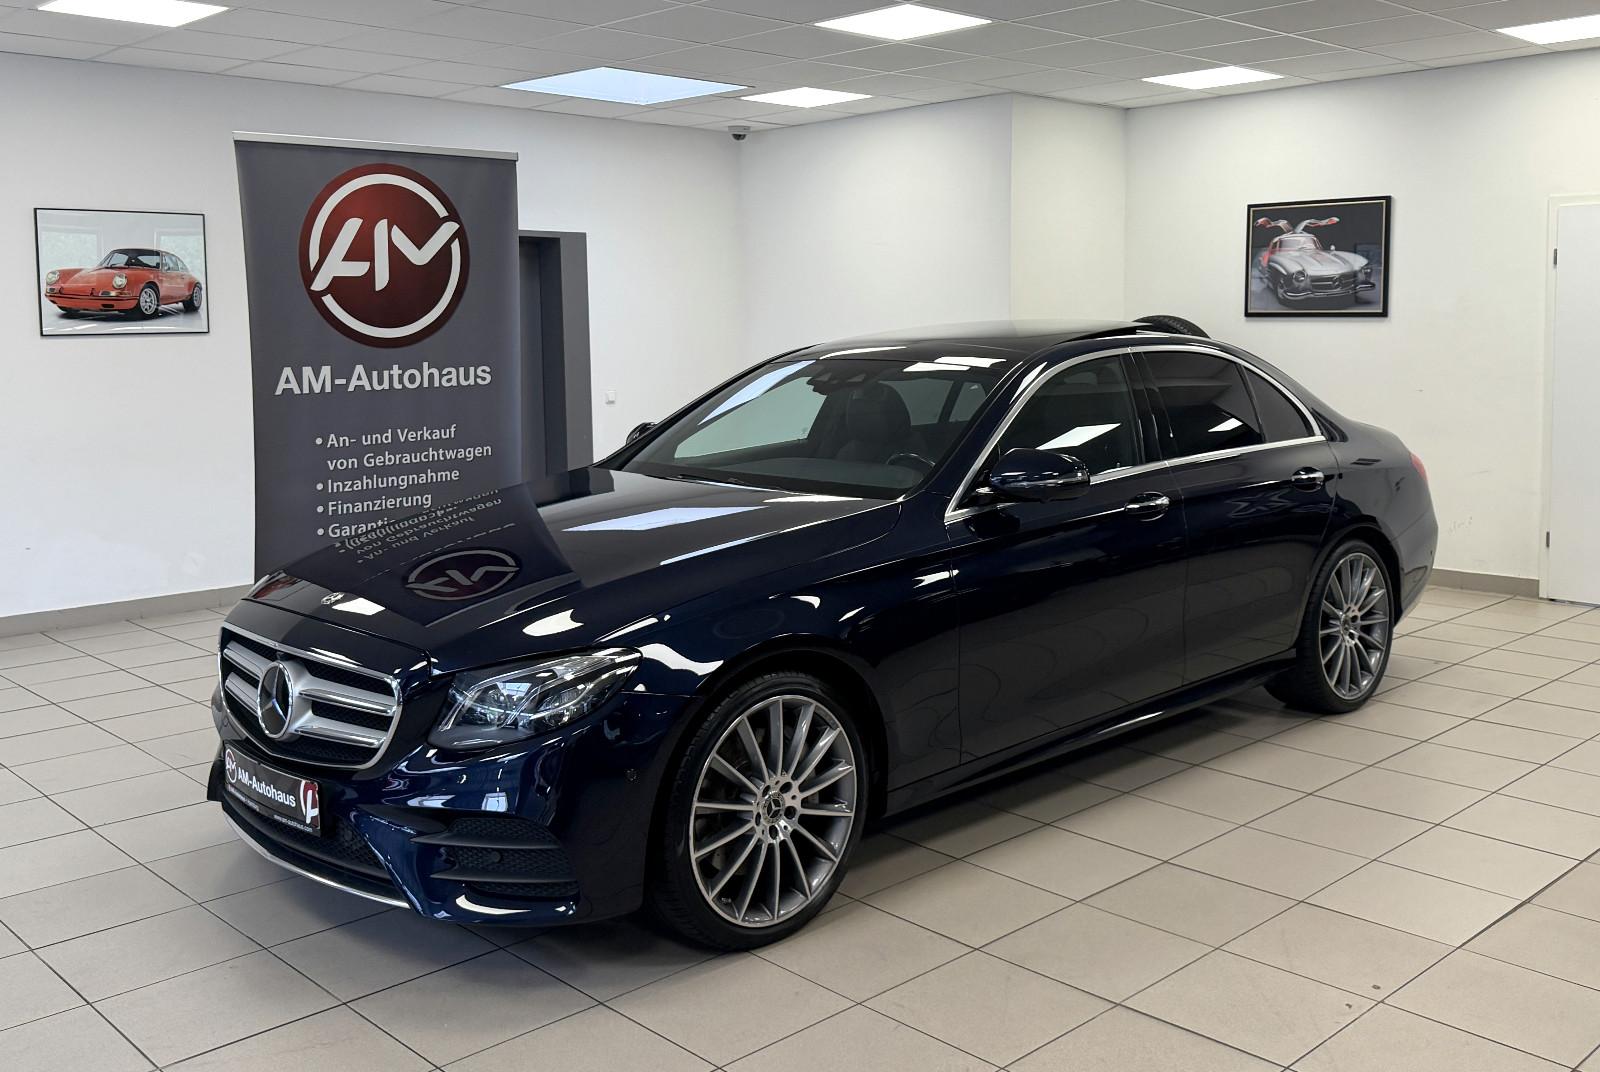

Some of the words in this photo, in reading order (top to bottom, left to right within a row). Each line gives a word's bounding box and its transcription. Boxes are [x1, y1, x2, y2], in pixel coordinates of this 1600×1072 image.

[310, 217, 460, 292] AM
[275, 362, 492, 395] AM-Autohaus
[327, 433, 356, 449] An-
[362, 429, 392, 445] und
[397, 424, 457, 443] Verkauf
[327, 456, 358, 471] von
[363, 445, 492, 468] Gebrauchtwagen
[328, 469, 460, 493] Inzahlungnahme
[328, 492, 432, 515] Finanzierung
[238, 766, 296, 807] AM-Autohaus
